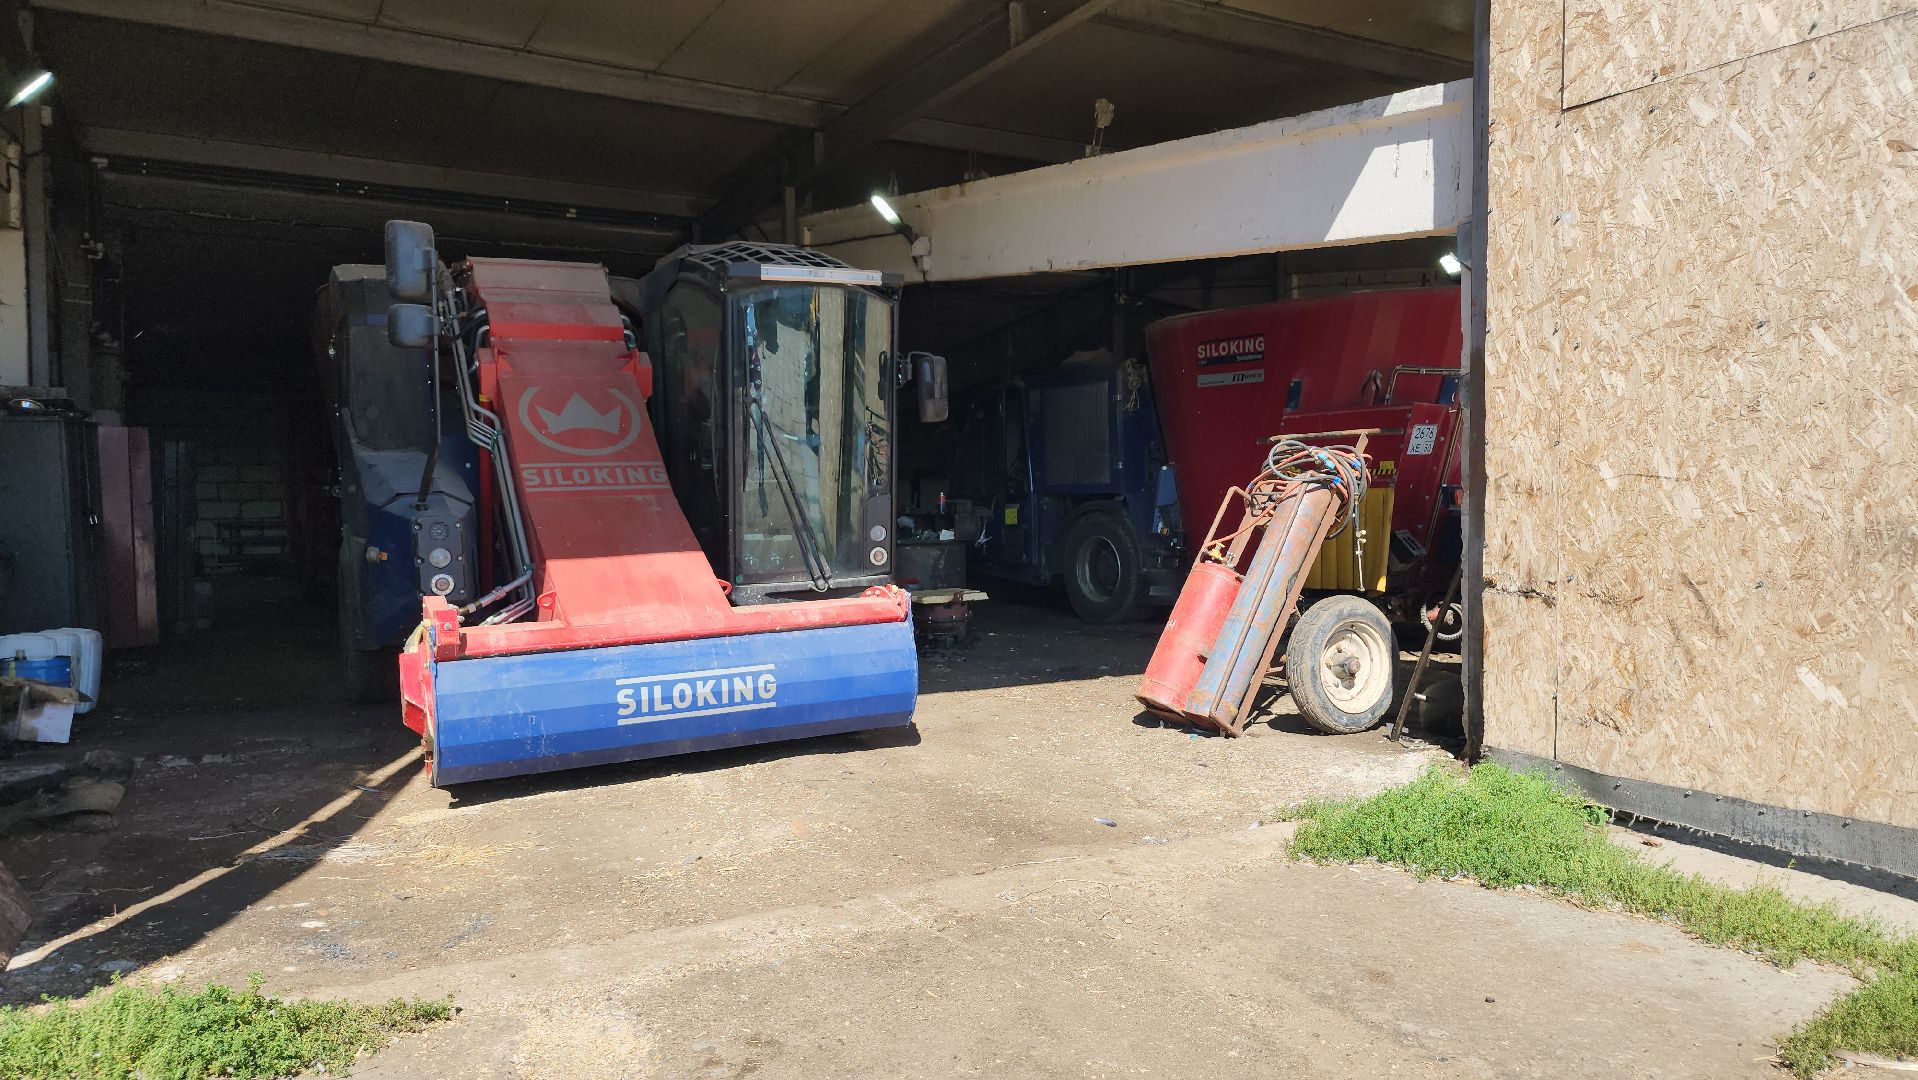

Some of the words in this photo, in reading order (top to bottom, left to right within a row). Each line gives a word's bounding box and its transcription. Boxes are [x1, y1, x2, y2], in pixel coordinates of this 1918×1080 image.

[1198, 337, 1264, 359] SILOKING
[1415, 427, 1435, 439] 2676
[523, 467, 670, 486] SILOKING
[616, 673, 777, 716] SILOKING
